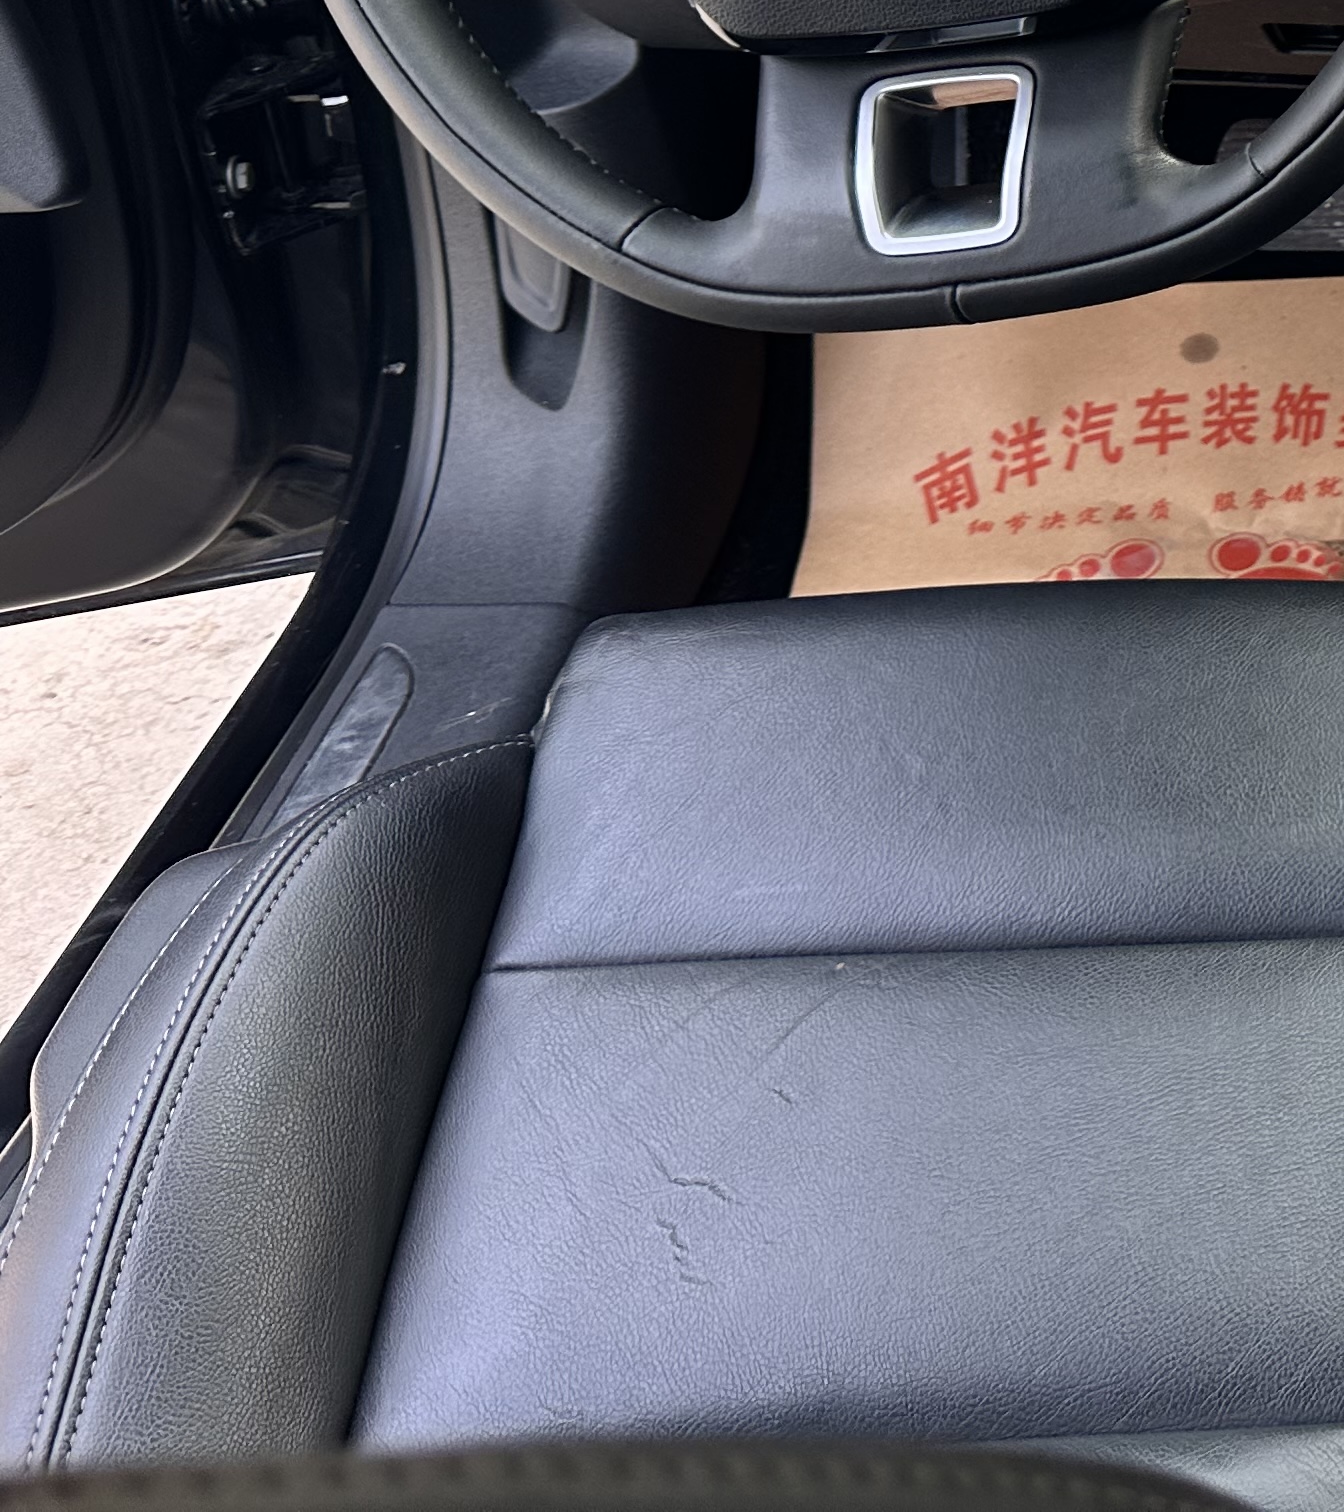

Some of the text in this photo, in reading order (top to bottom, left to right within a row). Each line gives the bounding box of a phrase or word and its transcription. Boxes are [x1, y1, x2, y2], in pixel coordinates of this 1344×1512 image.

[967, 498, 1172, 536] 细节决定品质
